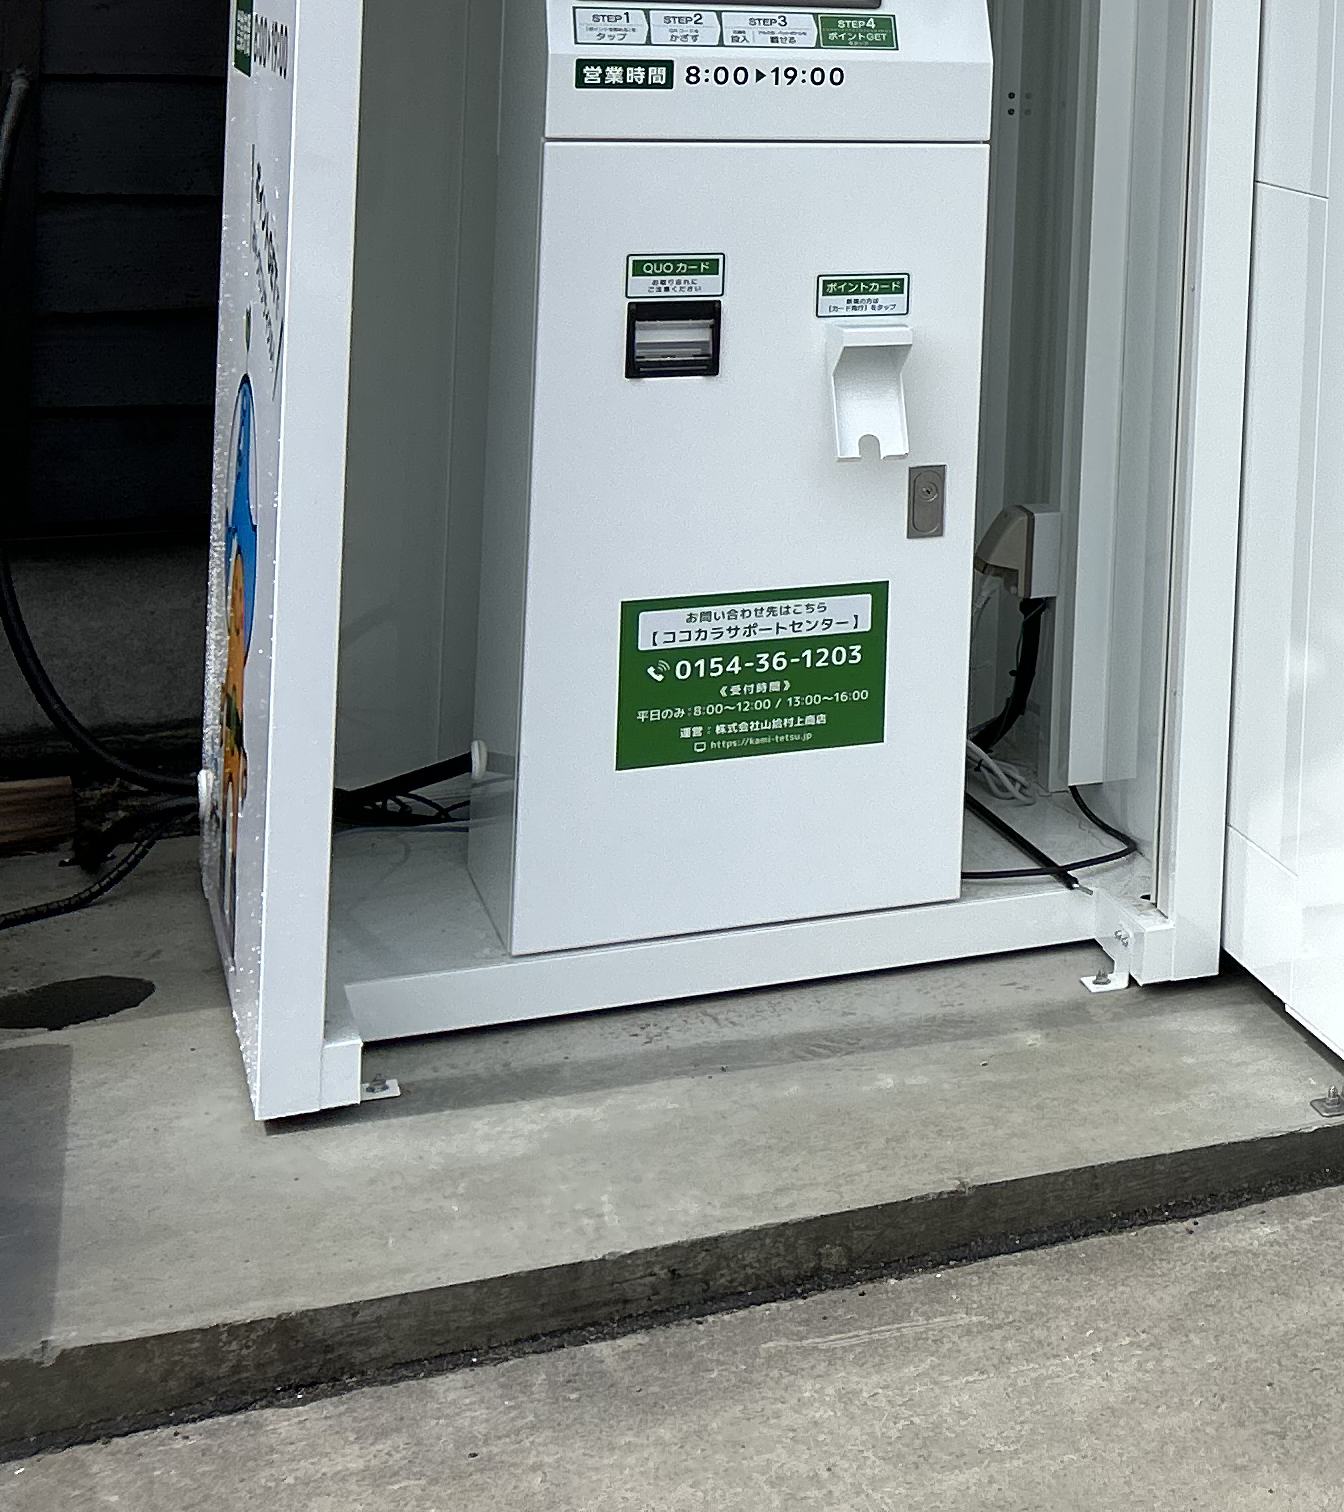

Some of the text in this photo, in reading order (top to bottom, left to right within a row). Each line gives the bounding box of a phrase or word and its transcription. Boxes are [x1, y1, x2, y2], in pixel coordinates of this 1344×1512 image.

[591, 12, 631, 24] STEP1
[663, 13, 703, 25] STEP2
[748, 15, 788, 28] STEP3
[837, 18, 876, 30] STEP4
[828, 32, 887, 41] ポイントGET
[582, 65, 845, 87] 営業時間 8:00 19:00
[826, 281, 900, 294] ポイントカード
[686, 602, 828, 624] お問い合わせ先はこちら
[676, 645, 863, 680] 0154-36-1203
